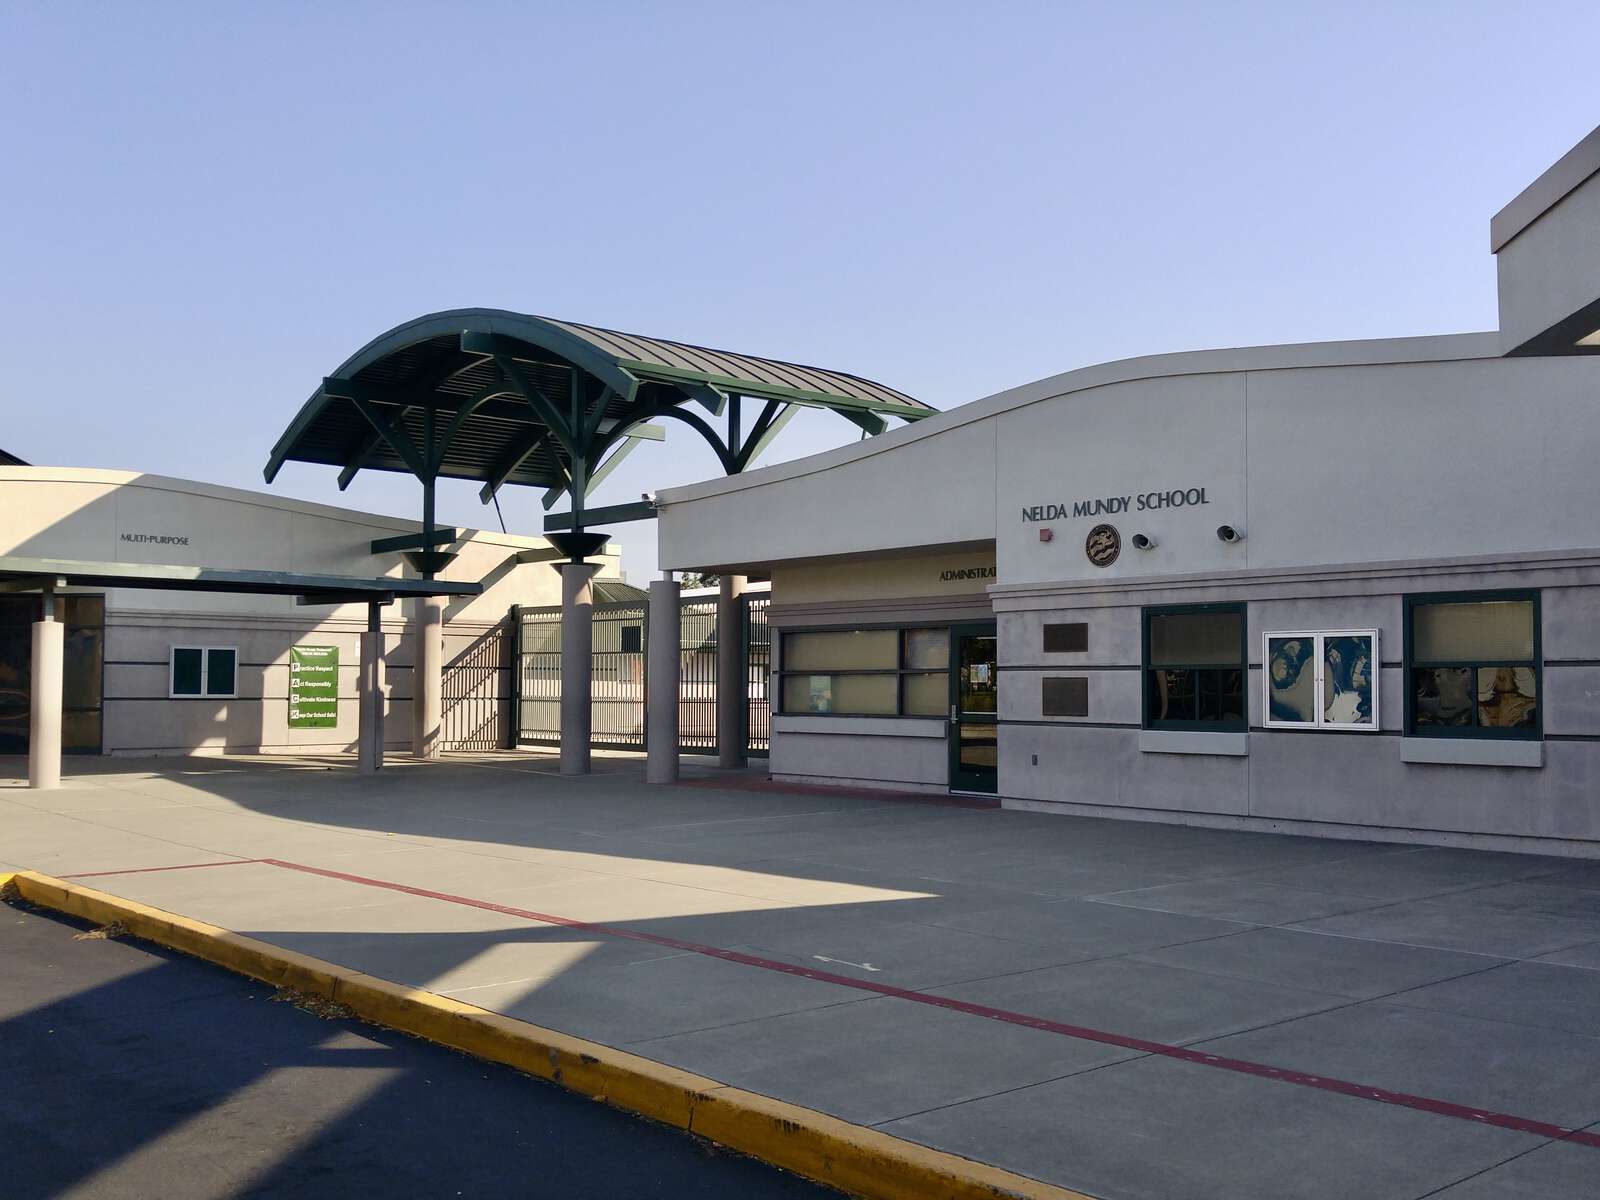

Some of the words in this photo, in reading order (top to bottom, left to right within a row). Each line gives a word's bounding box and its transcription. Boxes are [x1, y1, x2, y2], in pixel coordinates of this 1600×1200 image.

[1022, 504, 1068, 522] NELDA
[1073, 496, 1132, 518] MUNDY
[1137, 488, 1210, 511] SCHOOL
[120, 533, 189, 546] MULTI-PURPOSE
